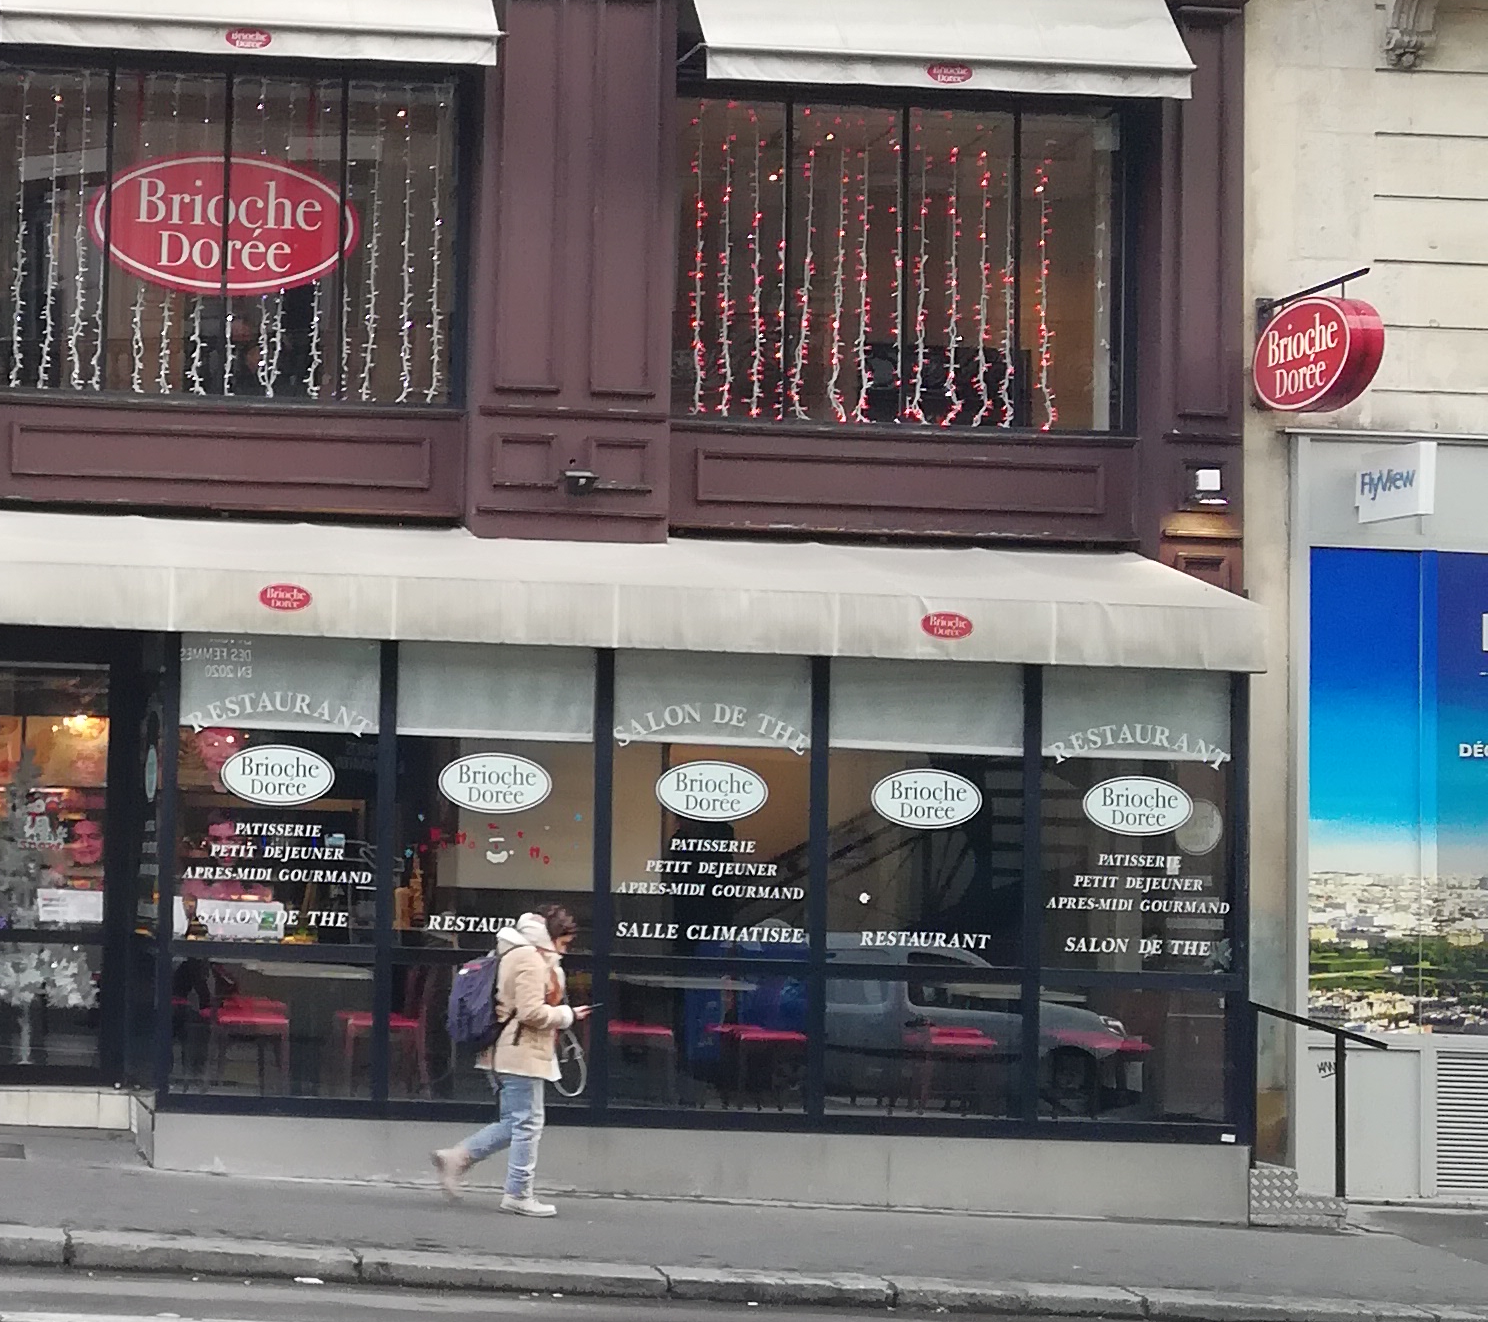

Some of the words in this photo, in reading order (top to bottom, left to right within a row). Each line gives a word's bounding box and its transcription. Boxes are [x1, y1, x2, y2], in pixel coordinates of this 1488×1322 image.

[135, 177, 322, 231] Brioche
[157, 229, 291, 273] Dorée
[1268, 313, 1338, 367] Brioche
[1275, 353, 1327, 399] Dorée
[1360, 469, 1416, 501] FlyView
[266, 587, 307, 600] Brioche
[929, 615, 968, 628] Brioche
[185, 691, 375, 738] RESTAURANT
[613, 702, 702, 747] SALON
[714, 703, 748, 727] DE
[758, 713, 810, 756] THE
[1049, 723, 1231, 771] RESTAURANT
[1458, 740, 1488, 758] DÉ
[240, 756, 320, 778] Brioche
[458, 764, 538, 787] Brioche
[250, 778, 307, 797] Dorée
[674, 772, 754, 795] Brioche
[889, 780, 967, 803] Brioche
[467, 785, 525, 805] Dorée
[685, 793, 741, 813] Dorée
[1101, 787, 1179, 810] Brioche
[899, 801, 955, 820] Dorée
[1111, 807, 1167, 827] Dorée
[234, 822, 323, 838] PATISSERIE
[209, 843, 257, 858] PETIT
[263, 845, 344, 862] DEJEUNER
[670, 838, 757, 854] PATISSERIE
[645, 859, 693, 874] PETIT
[698, 861, 778, 878] DEJEUNER
[1097, 853, 1183, 869] PATISSERIE
[181, 866, 272, 881] APRES-MIDI
[278, 868, 372, 884] GOURMAND
[1073, 874, 1119, 889] PETIT
[1125, 876, 1203, 893] DEJEUNER
[617, 881, 707, 897] APRES-MIDI
[712, 883, 805, 900] GOURMAND
[1045, 896, 1133, 911] APRES-MIDI
[1139, 898, 1230, 914] GOURMAND
[197, 908, 264, 925] SALON
[272, 909, 300, 926] DE
[308, 910, 350, 927] THE
[428, 914, 517, 932] RESTAUR
[616, 922, 680, 940] SALLE
[686, 924, 805, 944] CLIMATISEE
[860, 930, 992, 950] RESTAURANT
[1064, 936, 1130, 954] SALON
[1137, 938, 1163, 956] DE
[1171, 939, 1211, 957] THE
